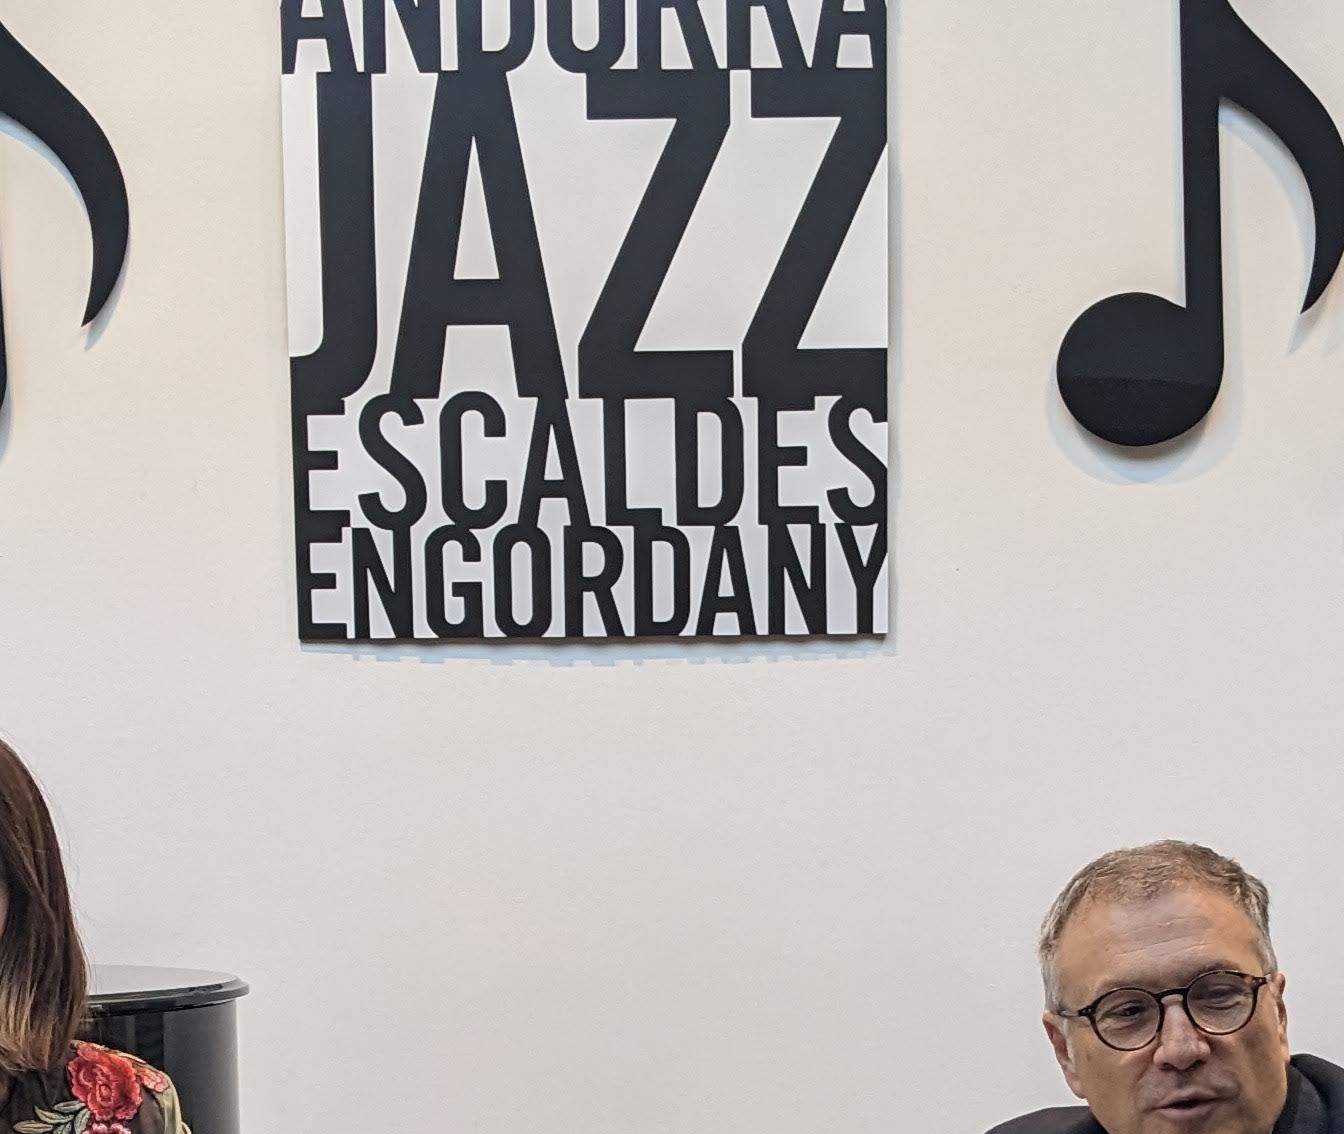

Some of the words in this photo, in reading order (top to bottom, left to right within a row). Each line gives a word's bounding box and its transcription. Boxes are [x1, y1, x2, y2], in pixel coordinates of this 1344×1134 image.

[288, 68, 888, 400] JAZZ
[291, 392, 888, 531] ESCALDES
[294, 524, 888, 639] ENGORDANY
